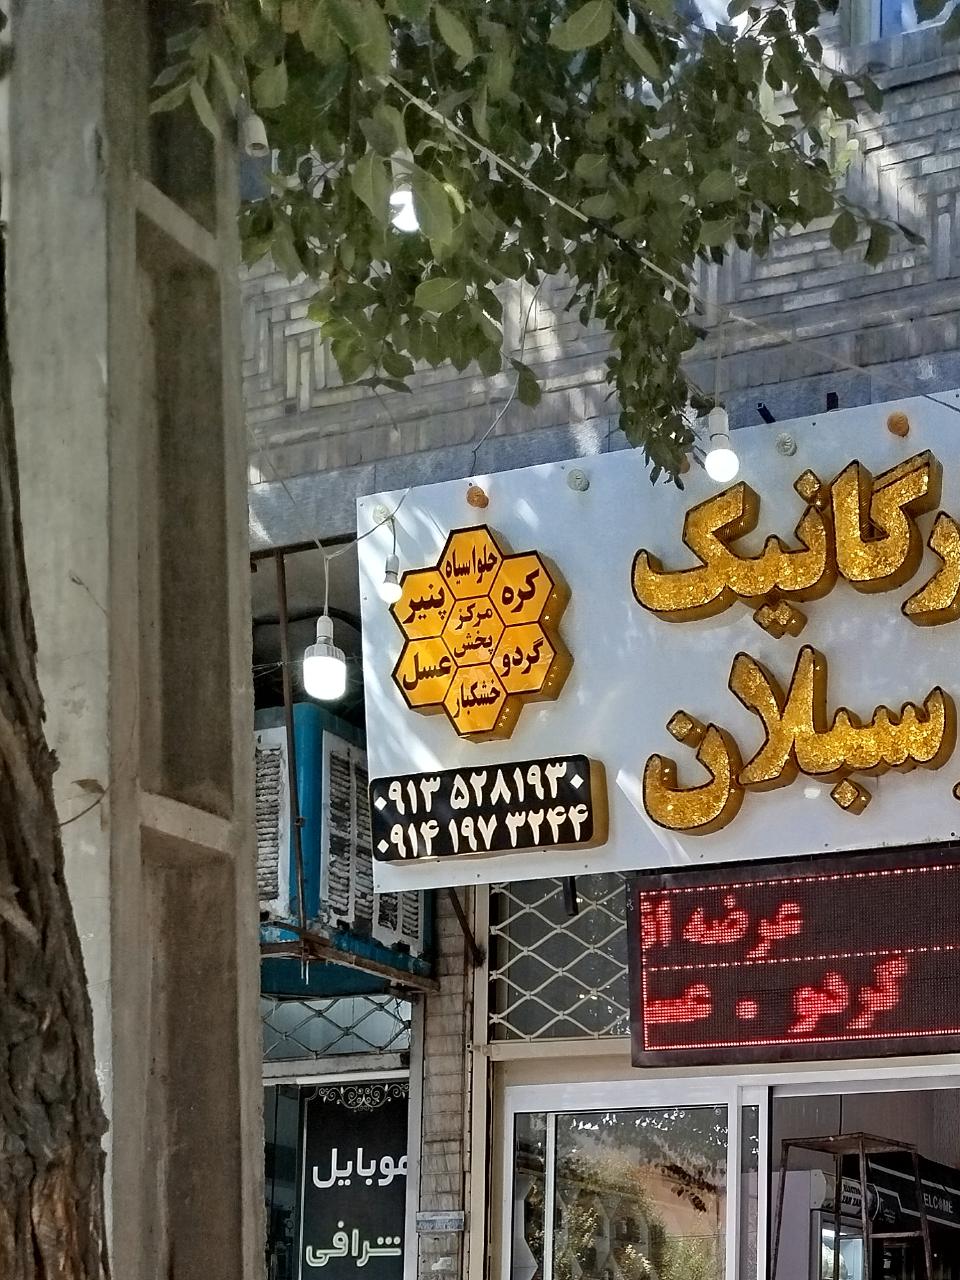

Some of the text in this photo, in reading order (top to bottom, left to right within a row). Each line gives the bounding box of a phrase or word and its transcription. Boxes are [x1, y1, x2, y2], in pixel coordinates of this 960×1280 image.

[446, 544, 498, 585] حلوا سیاه
[402, 584, 447, 624] پنیر
[501, 568, 540, 613] کره
[455, 603, 493, 630] مرکز
[454, 631, 494, 658] پخش
[500, 637, 544, 677] گردو
[402, 652, 451, 691] عسل
[453, 679, 501, 718] خشکبار
[643, 644, 957, 836] سبلان
[313, 1147, 408, 1188] موبایل
[922, 1192, 954, 1214] ELCOME
